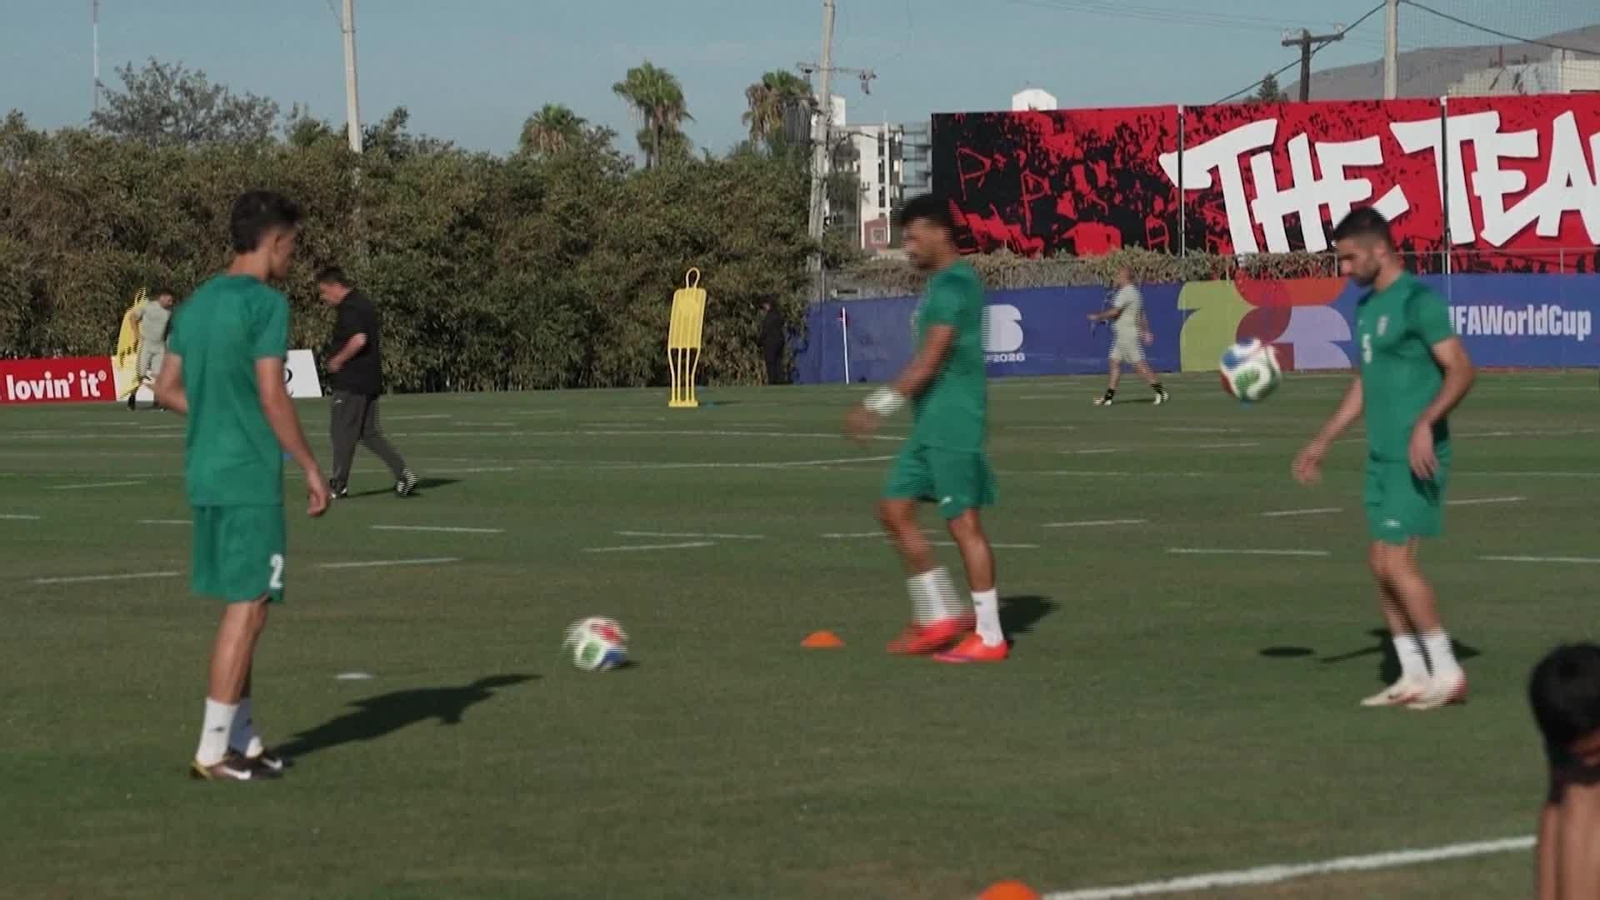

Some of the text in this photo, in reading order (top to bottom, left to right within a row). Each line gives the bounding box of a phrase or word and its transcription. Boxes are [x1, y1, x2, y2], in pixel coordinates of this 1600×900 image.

[1159, 110, 1600, 260] THE TEA
[1448, 304, 1591, 341] IFAWorldCup
[6, 371, 75, 400] lovin'
[270, 553, 284, 588] 2
